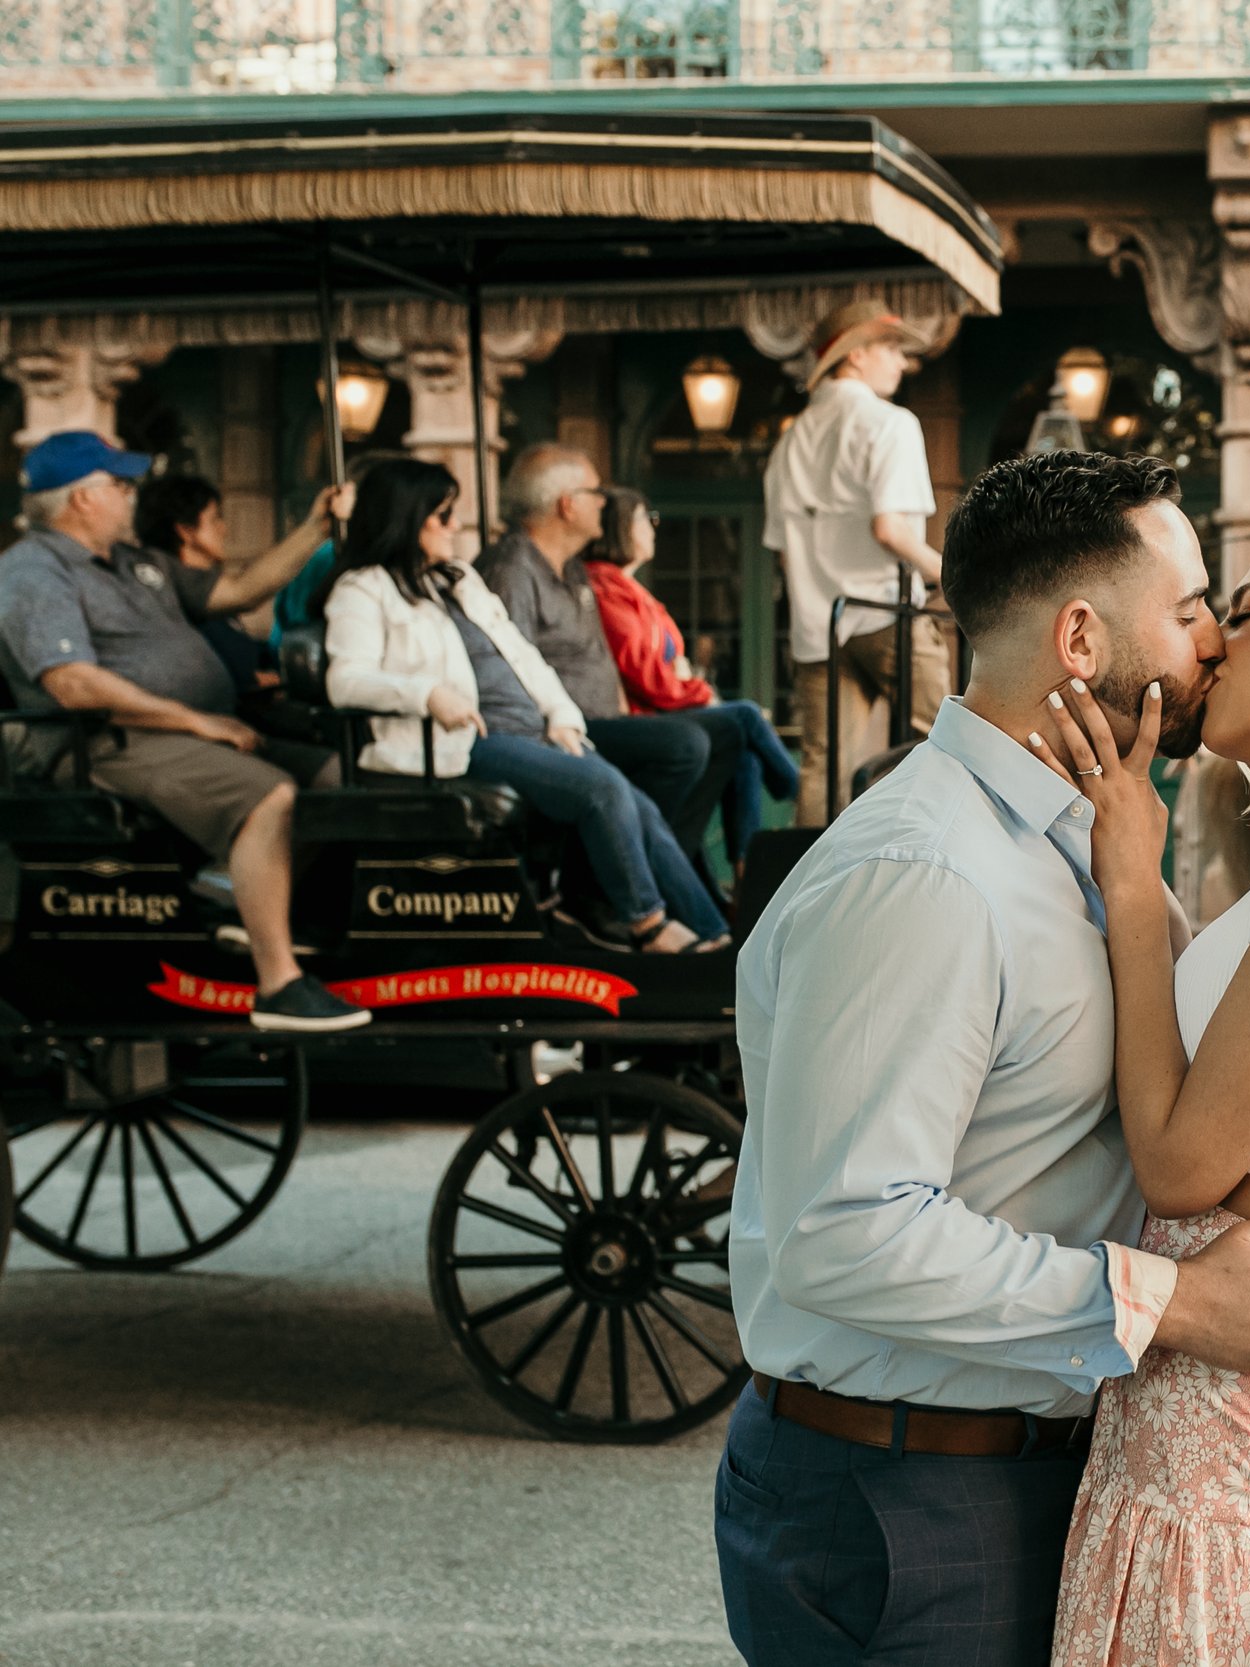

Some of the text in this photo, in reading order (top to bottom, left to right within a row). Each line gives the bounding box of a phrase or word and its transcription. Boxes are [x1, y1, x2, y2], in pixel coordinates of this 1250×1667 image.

[41, 885, 180, 924] Carriage
[367, 884, 520, 923] Company
[376, 974, 450, 1002] Meets
[462, 966, 611, 1003] Hospitality
